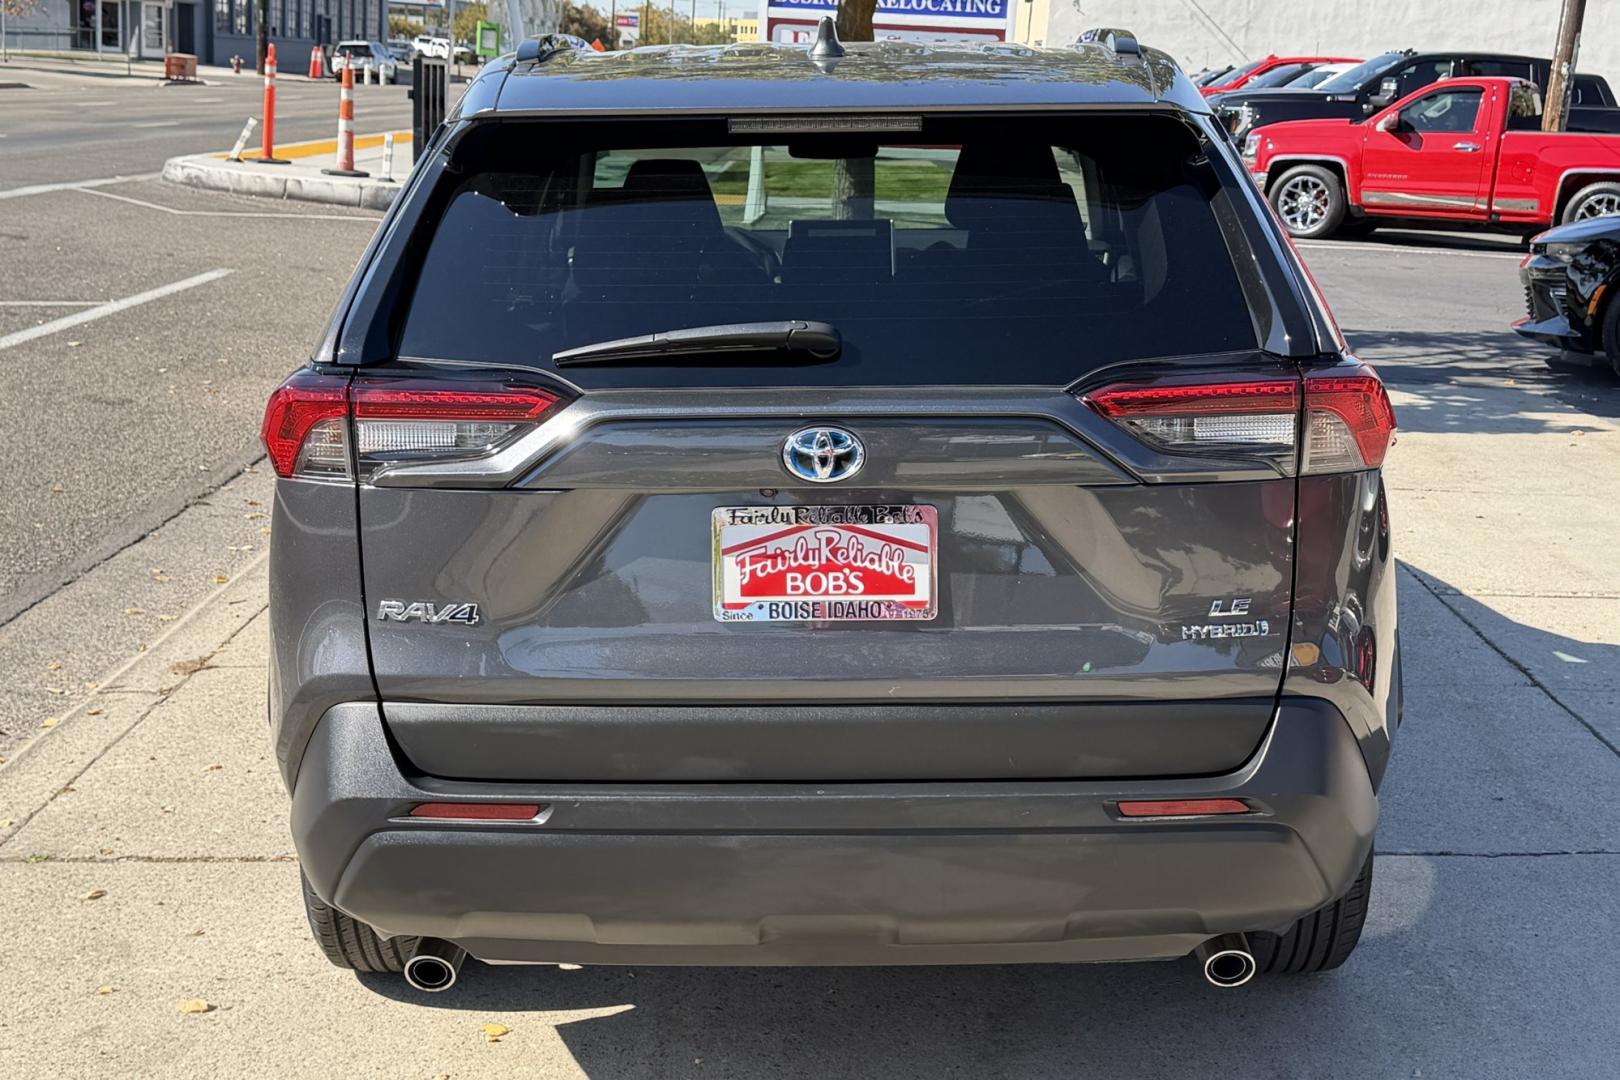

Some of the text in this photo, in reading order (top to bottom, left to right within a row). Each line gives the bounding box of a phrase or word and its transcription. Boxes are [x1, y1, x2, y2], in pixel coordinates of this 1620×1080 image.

[726, 506, 793, 525] Fairly
[735, 529, 915, 586] Fairly Reliable
[786, 568, 865, 595] BOB'S
[377, 600, 479, 625] RAV4
[722, 610, 754, 621] Since
[768, 601, 882, 619] BOISE IDAHO
[1208, 598, 1252, 617] LE
